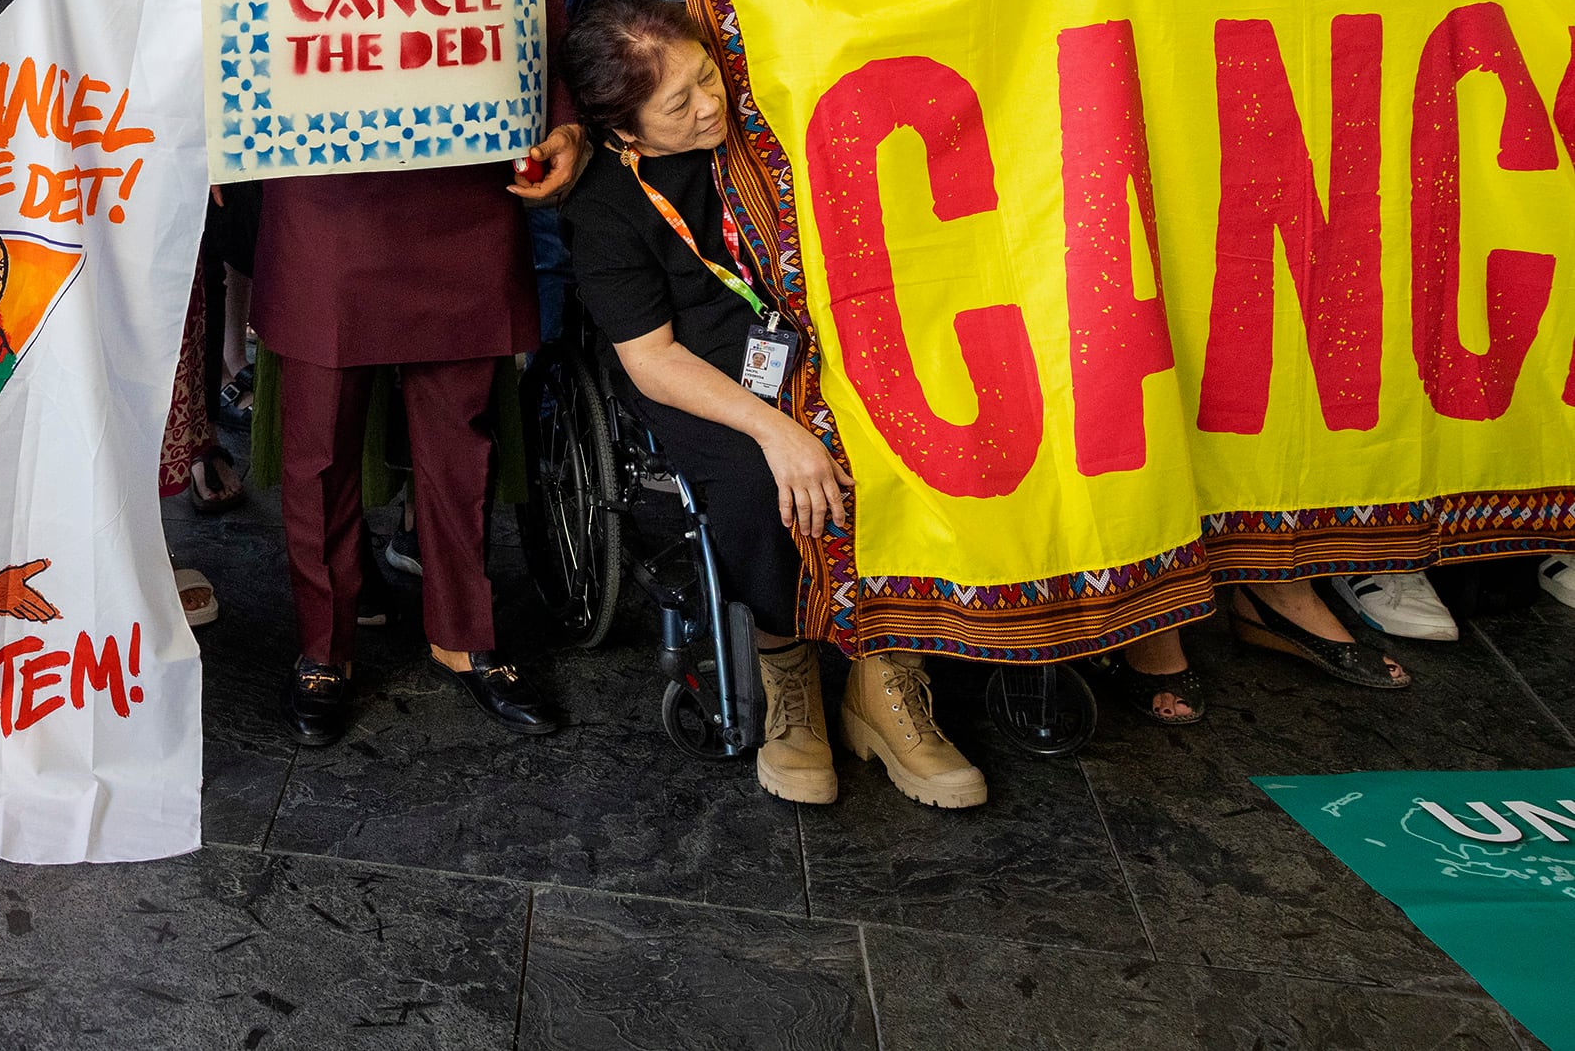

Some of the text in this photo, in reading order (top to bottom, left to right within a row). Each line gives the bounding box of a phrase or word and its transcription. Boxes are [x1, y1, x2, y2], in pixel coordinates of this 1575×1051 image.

[285, 23, 505, 76] THE DEBT
[805, 0, 1575, 500] CANC
